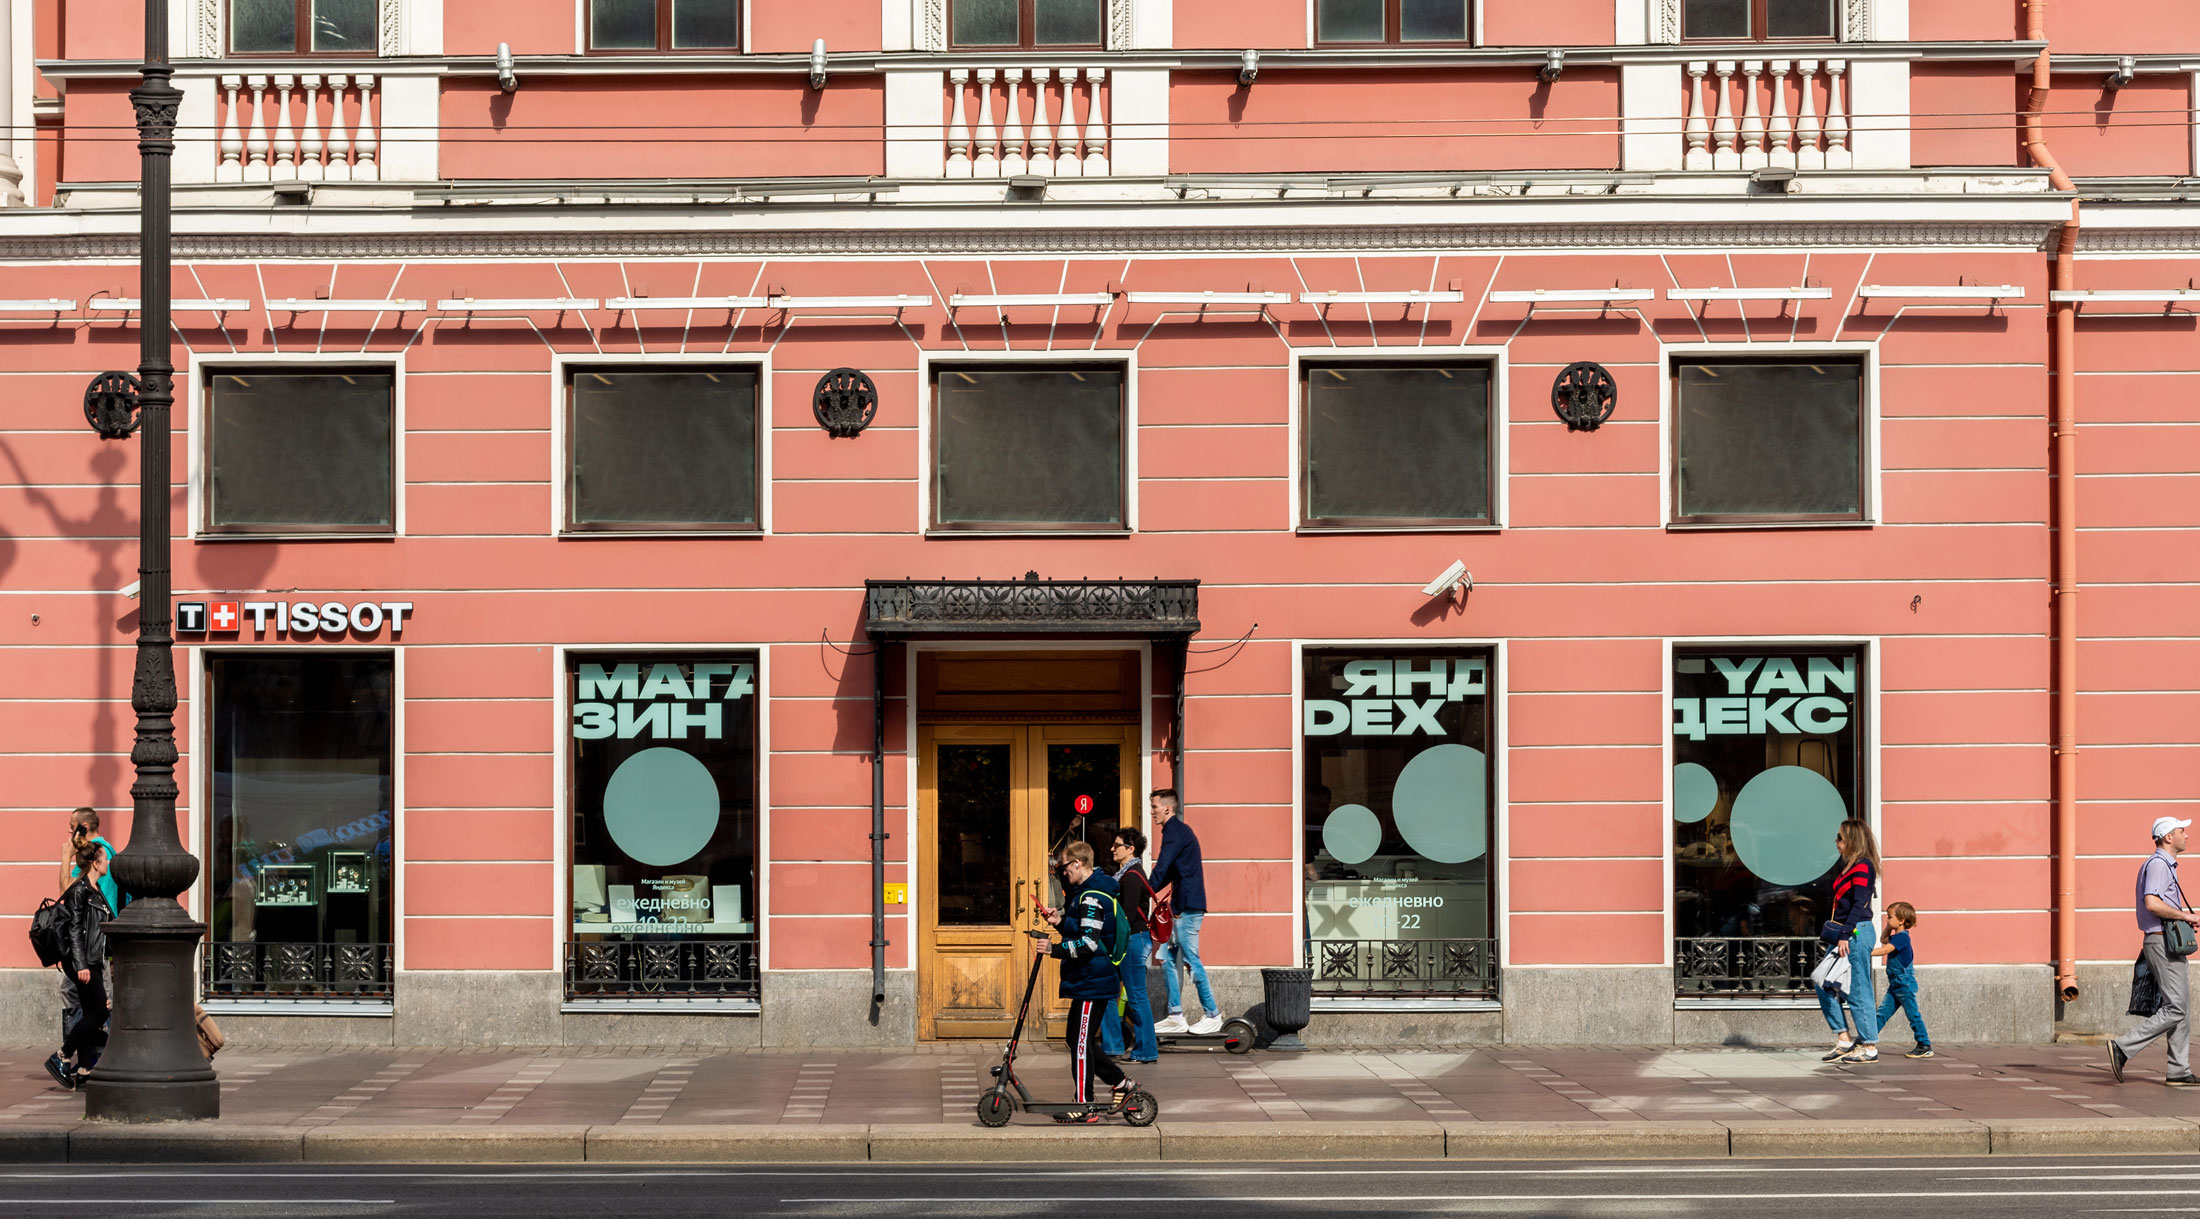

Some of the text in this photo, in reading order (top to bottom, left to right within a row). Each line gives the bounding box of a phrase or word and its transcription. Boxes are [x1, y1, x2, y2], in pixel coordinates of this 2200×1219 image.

[244, 601, 413, 633] TISSOT
[579, 663, 754, 699] МАГА
[1342, 659, 1486, 701] ЯНД
[1710, 656, 1856, 694] YAN
[573, 702, 722, 740] ЗИН
[1303, 699, 1448, 736] DEX
[616, 897, 711, 912] ежедневно
